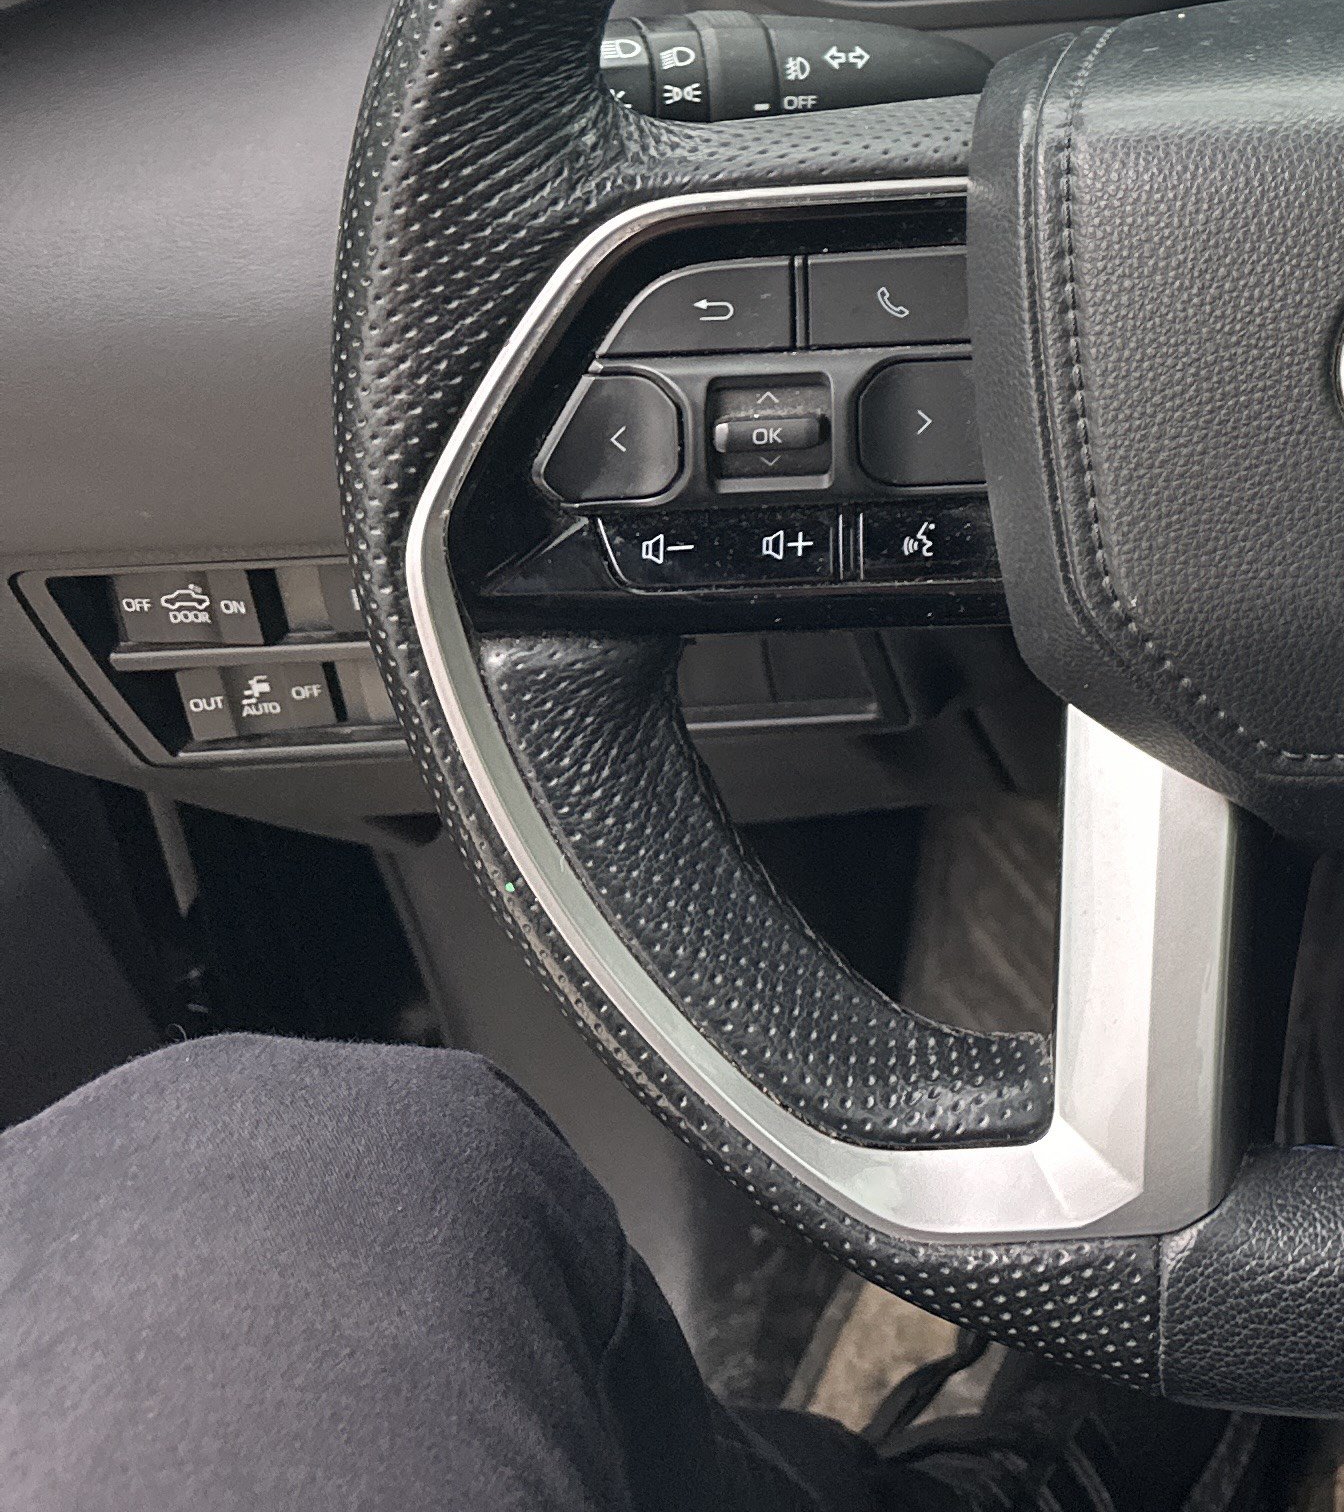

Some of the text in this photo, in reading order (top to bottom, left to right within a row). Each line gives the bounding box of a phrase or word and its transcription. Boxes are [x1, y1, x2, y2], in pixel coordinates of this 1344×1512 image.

[783, 94, 818, 111] OFF
[752, 426, 783, 445] OK
[123, 598, 246, 615] OFF ON
[169, 611, 211, 625] DOOR
[291, 683, 321, 700] OFF
[189, 695, 224, 714] OUT
[242, 701, 281, 717] AUTO
